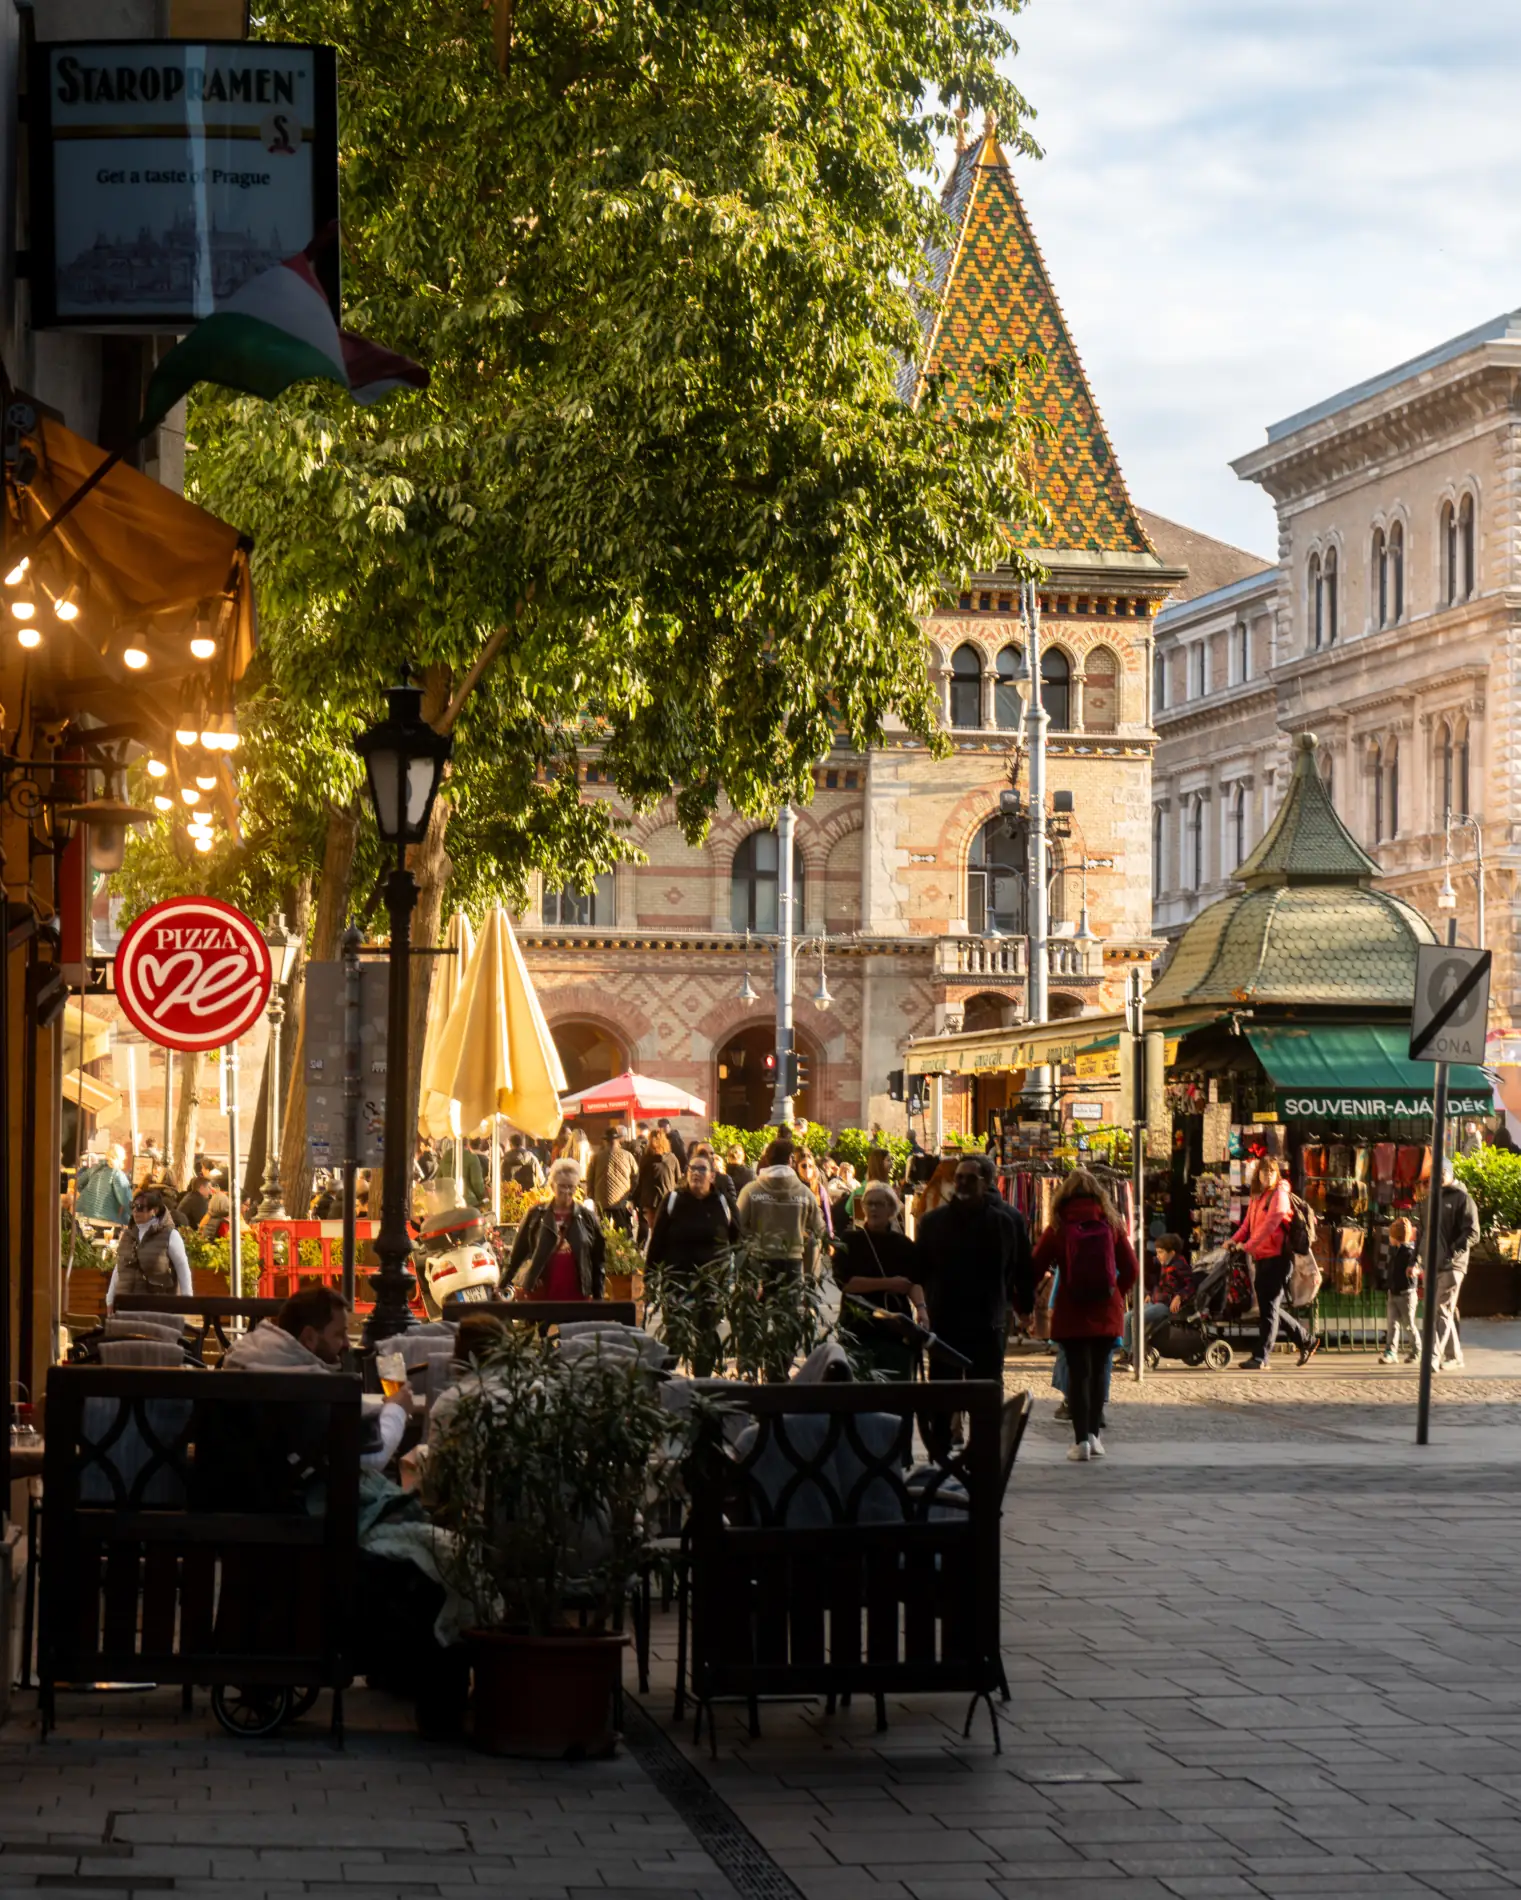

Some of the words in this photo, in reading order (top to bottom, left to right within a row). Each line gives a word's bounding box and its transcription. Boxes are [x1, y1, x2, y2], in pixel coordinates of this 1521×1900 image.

[96, 168, 126, 184] Get
[130, 171, 140, 184] a
[144, 168, 187, 184] taste
[189, 167, 209, 185] of
[212, 169, 271, 189] Prague
[154, 928, 239, 950] PIZZA
[1284, 1096, 1488, 1116] SOUVENIR-AJÁDÉK
